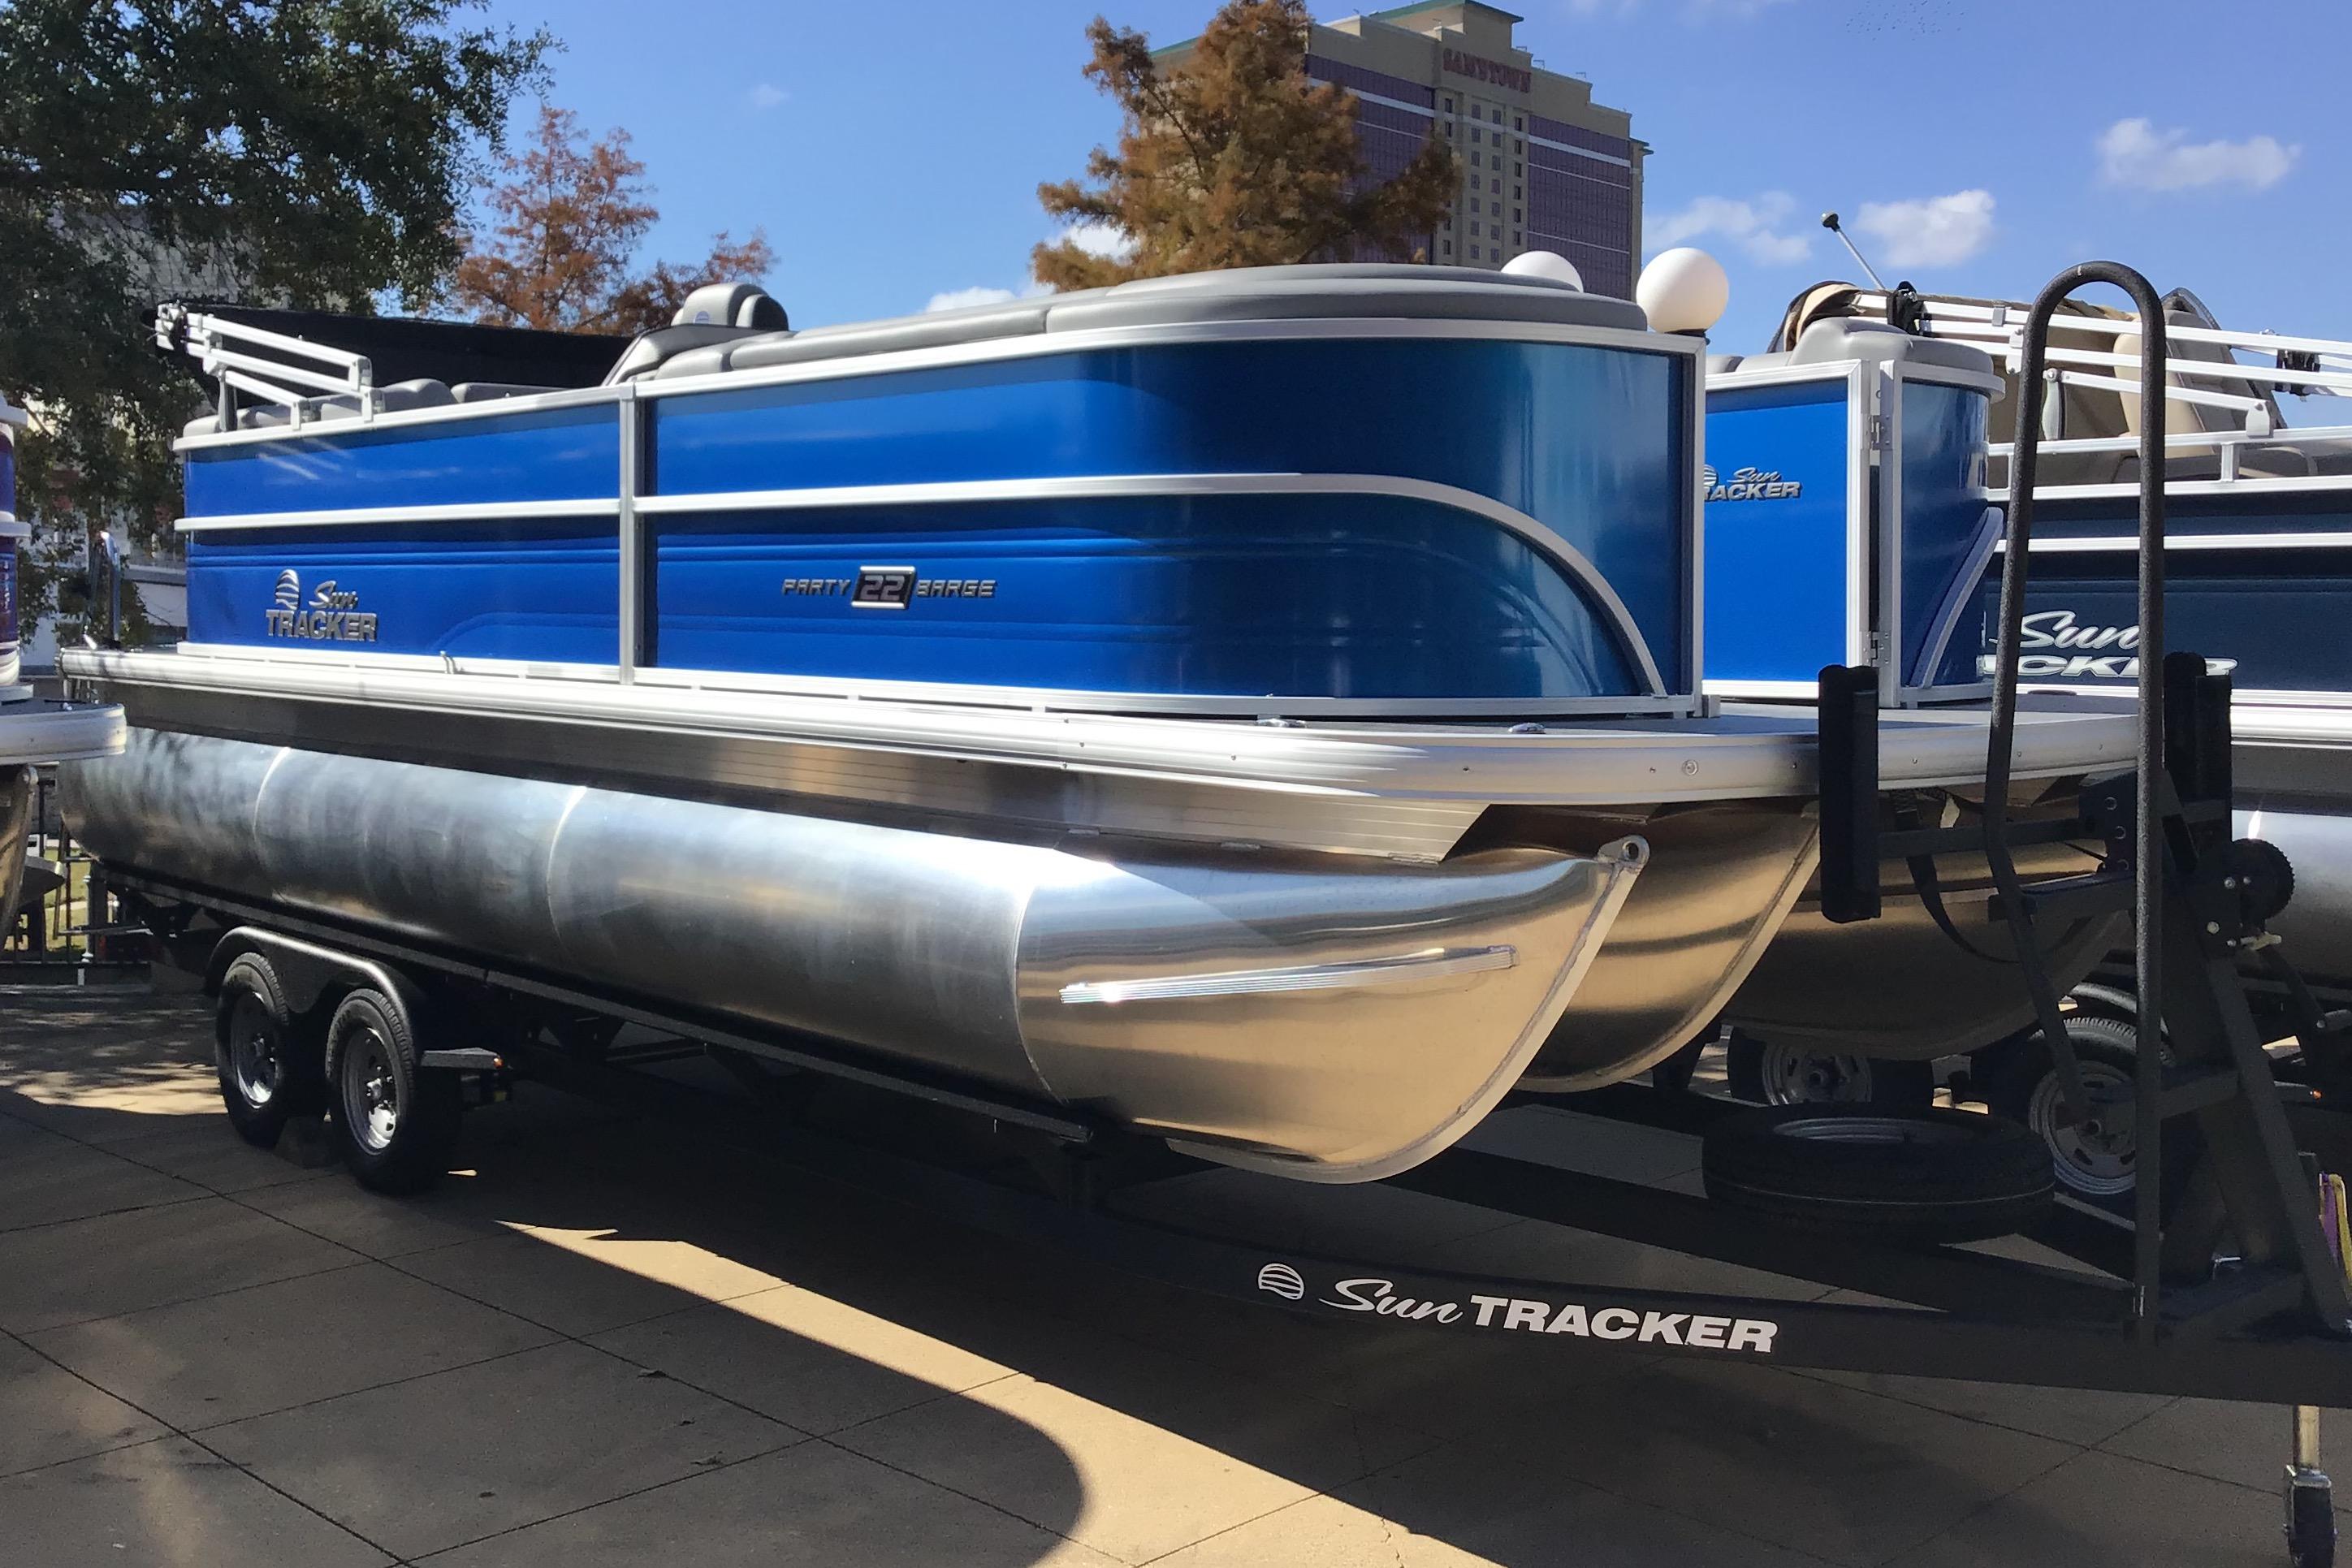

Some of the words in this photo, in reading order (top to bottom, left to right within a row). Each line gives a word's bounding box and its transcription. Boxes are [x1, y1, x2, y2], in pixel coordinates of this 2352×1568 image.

[1727, 467, 1782, 483] Sun
[1704, 482, 1801, 502] ACKER
[309, 580, 359, 609] Sun
[781, 578, 850, 596] PARTY
[860, 575, 906, 601] 22
[915, 580, 997, 598] BARGE
[266, 609, 378, 641] TRACKER
[1318, 1278, 1463, 1325] Sun
[1469, 1294, 1778, 1354] TRACKER
